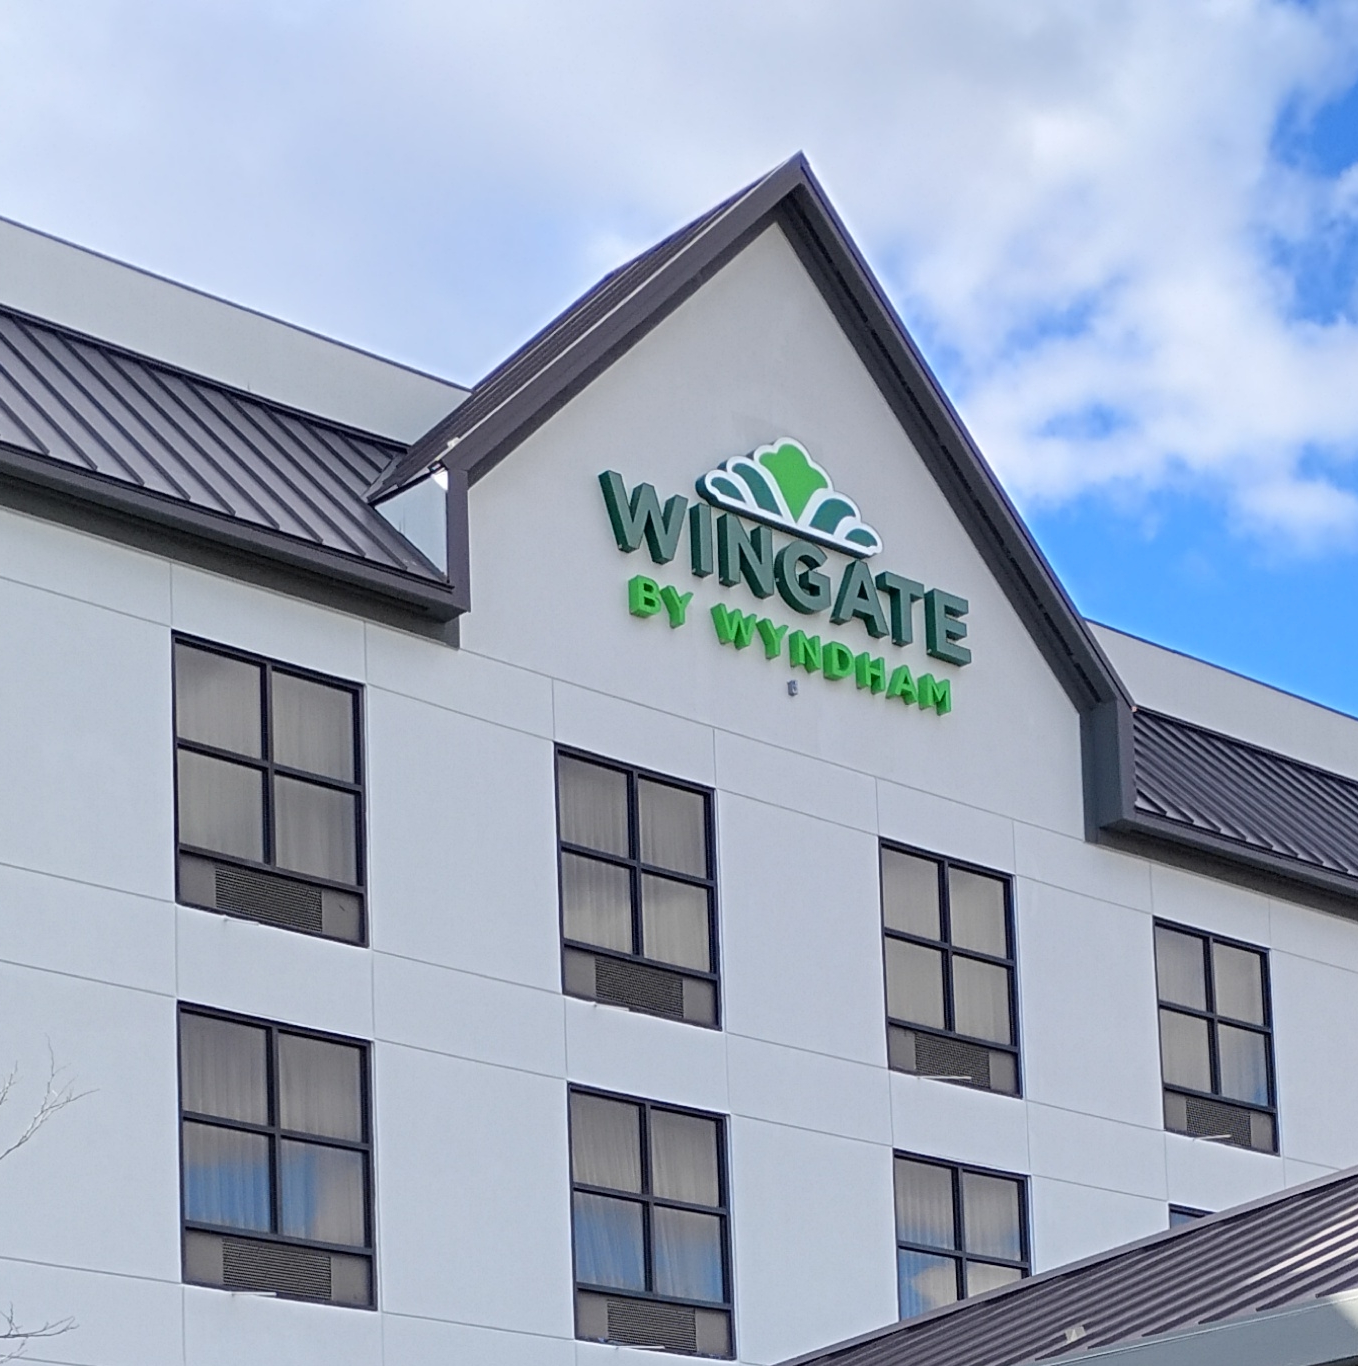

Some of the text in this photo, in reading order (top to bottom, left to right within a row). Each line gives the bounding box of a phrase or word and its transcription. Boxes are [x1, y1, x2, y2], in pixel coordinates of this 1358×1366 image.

[598, 470, 972, 667] WINGATE
[627, 574, 952, 716] BY WYNDHAM
